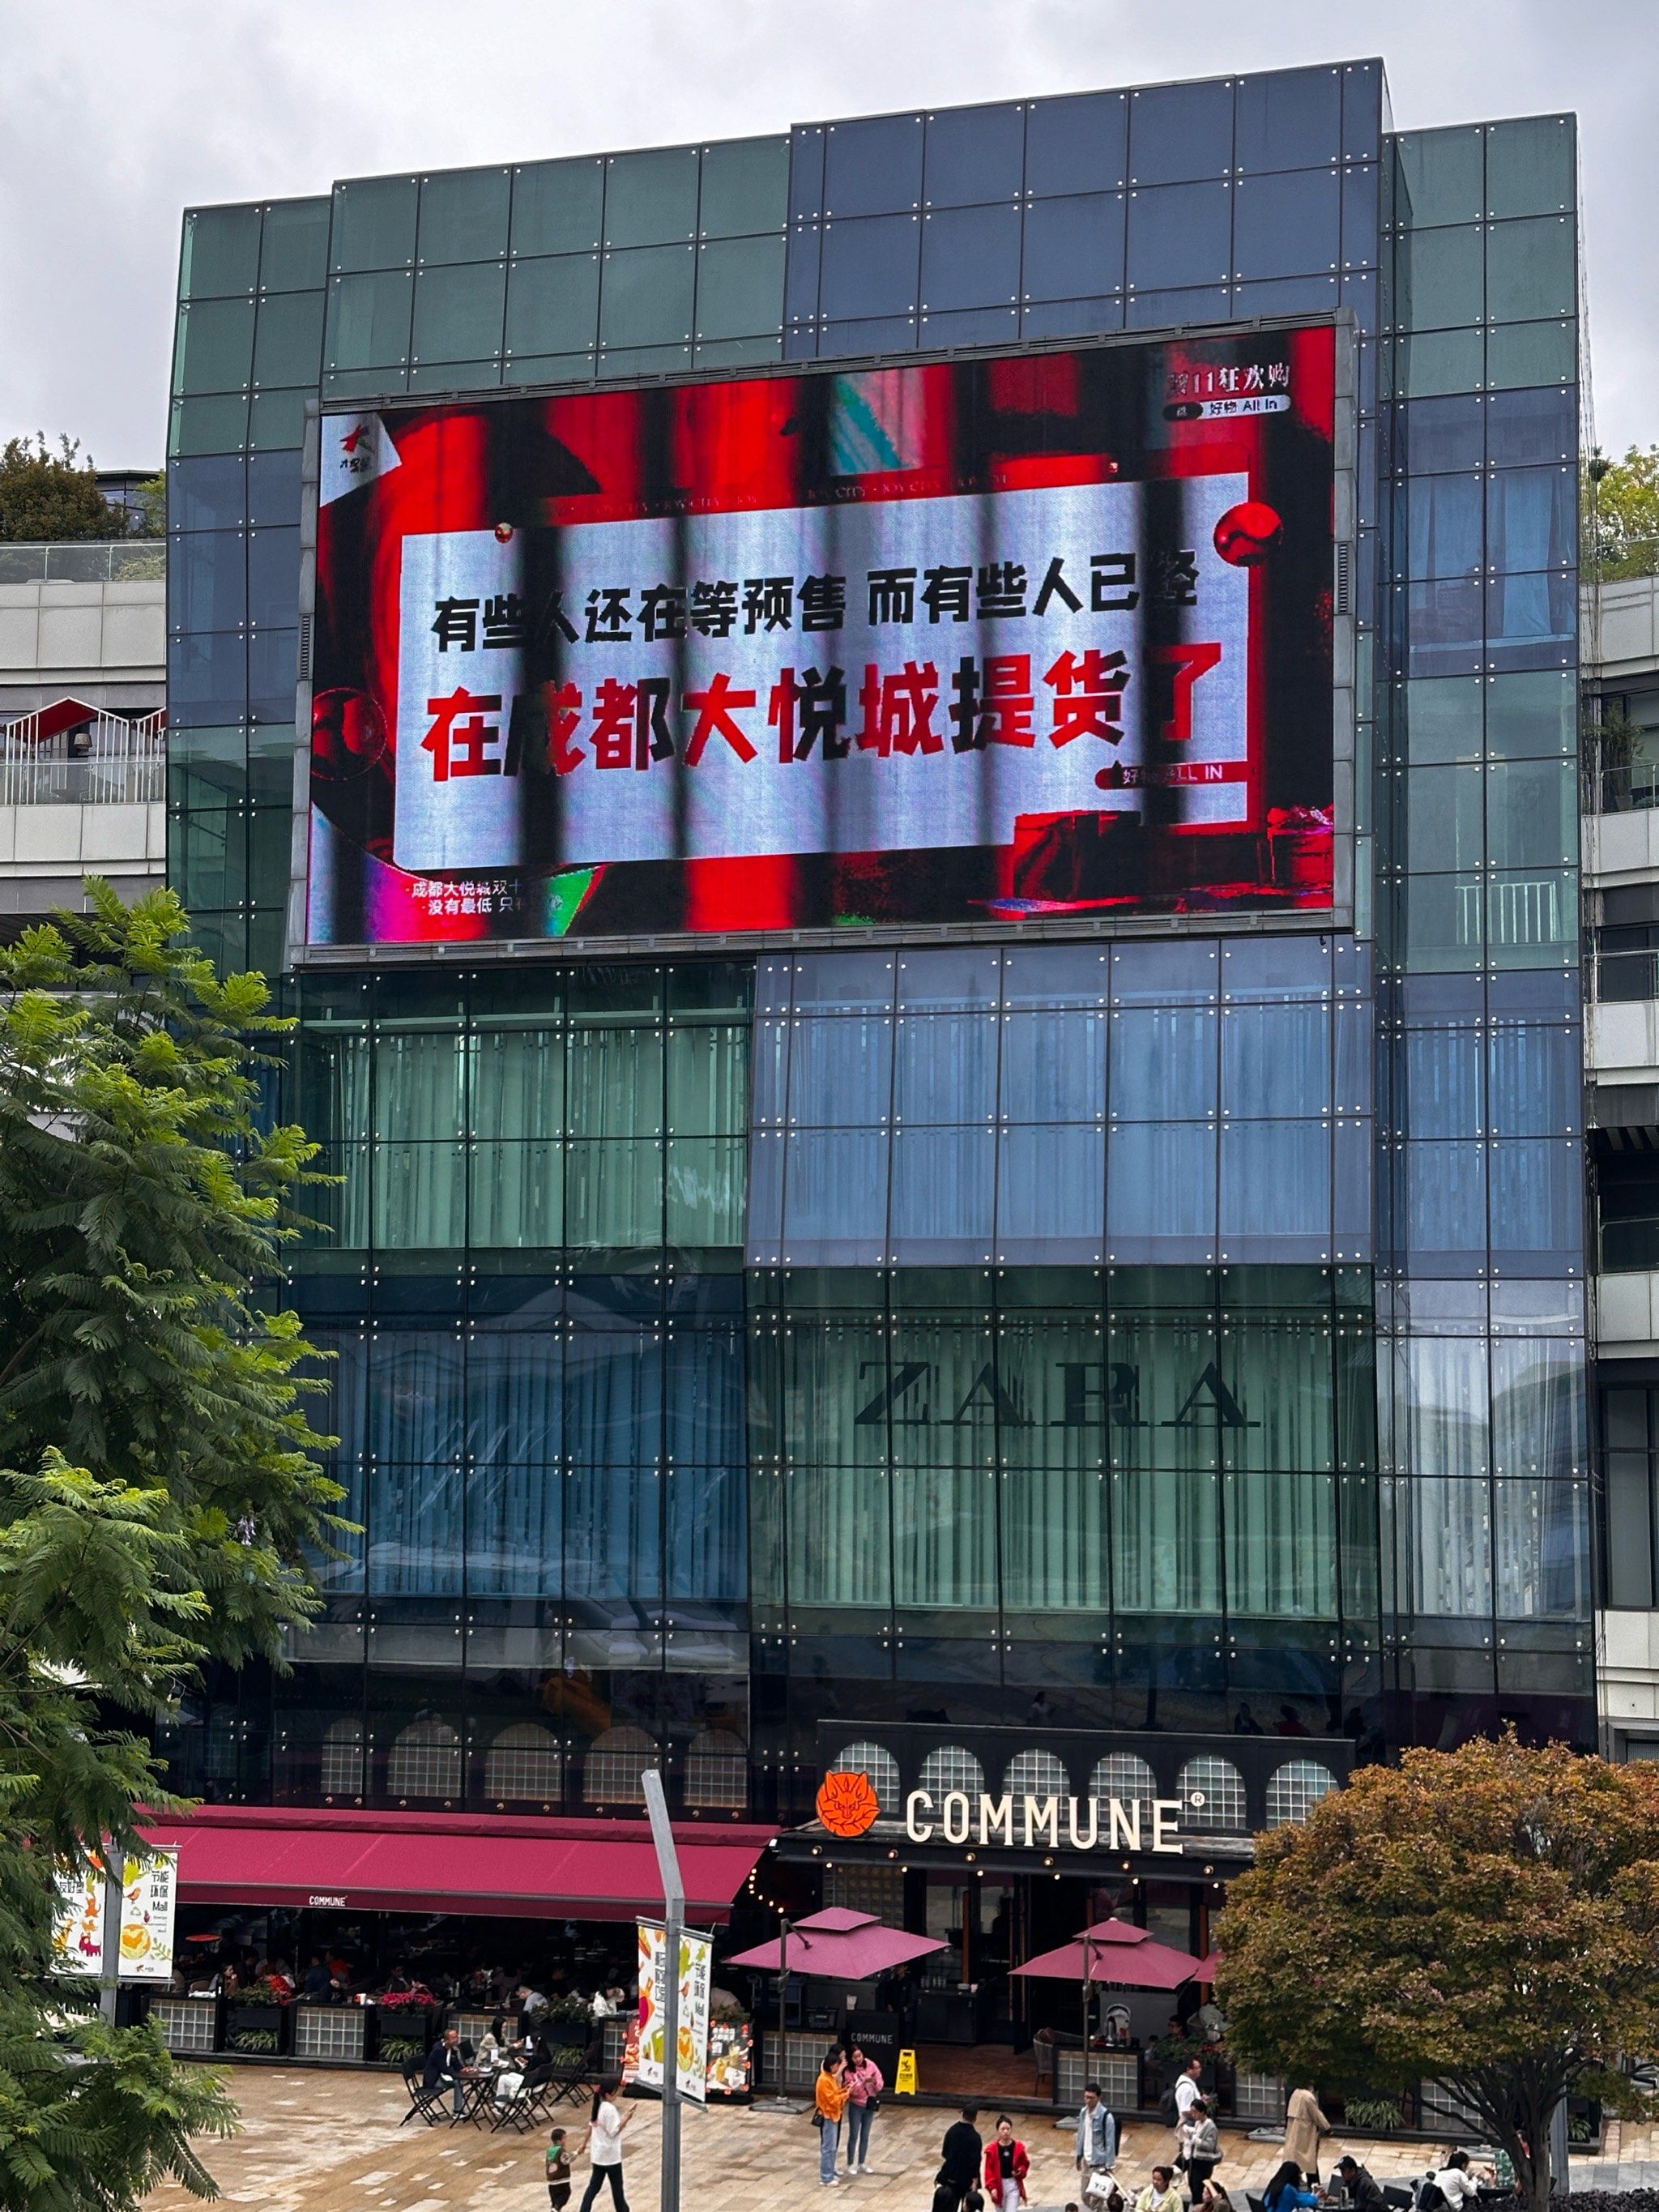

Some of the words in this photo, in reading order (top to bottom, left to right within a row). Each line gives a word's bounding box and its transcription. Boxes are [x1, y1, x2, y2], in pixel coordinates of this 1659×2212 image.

[1265, 397, 1277, 410] In
[430, 574, 847, 652] 有些人还在等预售
[420, 642, 1222, 782] 在成都大悦城提货了
[1205, 764, 1222, 779] IN
[854, 1362, 1260, 1428] ZARA
[906, 1790, 1183, 1854] COMMUNE
[152, 1901, 168, 1911] Mall
[309, 1896, 346, 1907] COMMUNE
[851, 2033, 893, 2043] COMMUNE
